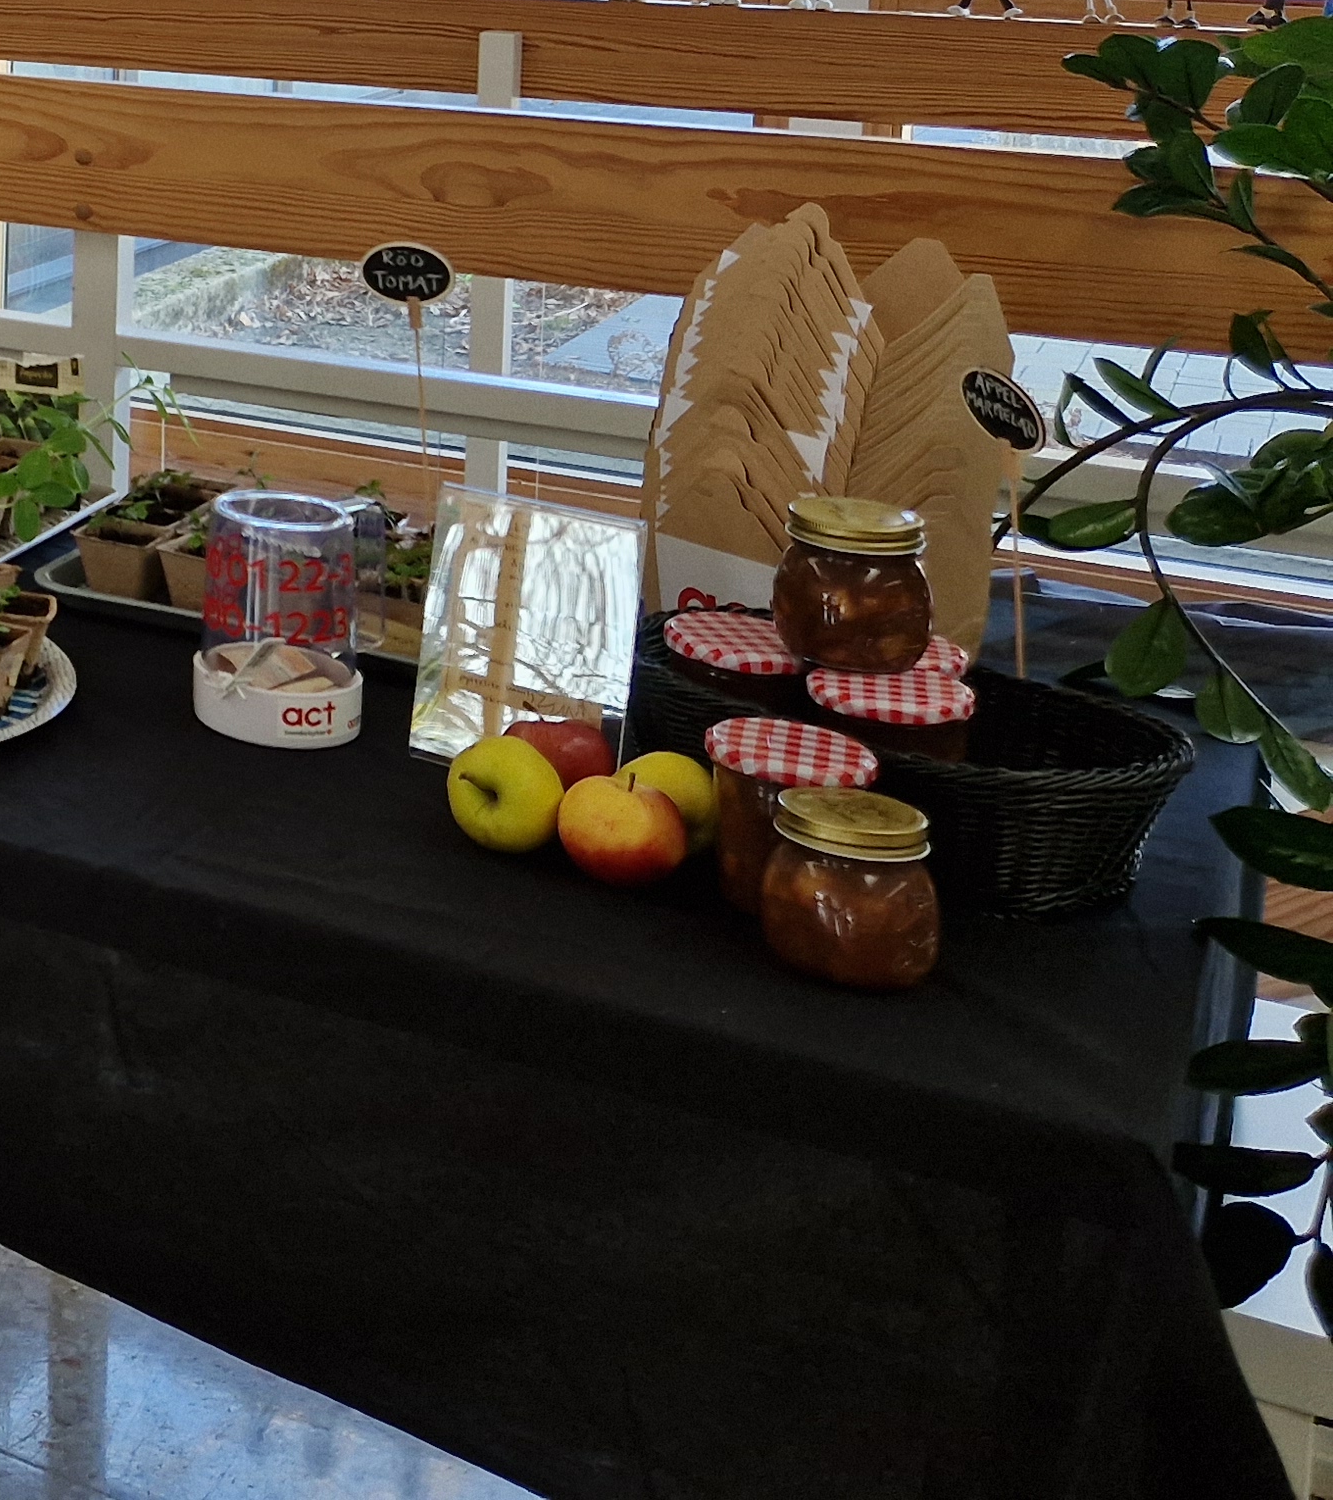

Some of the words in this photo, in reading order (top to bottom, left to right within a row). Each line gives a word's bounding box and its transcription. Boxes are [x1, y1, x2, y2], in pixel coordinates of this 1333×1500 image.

[381, 249, 424, 267] RÖD
[373, 270, 443, 294] TOMAT
[281, 701, 336, 727] act
